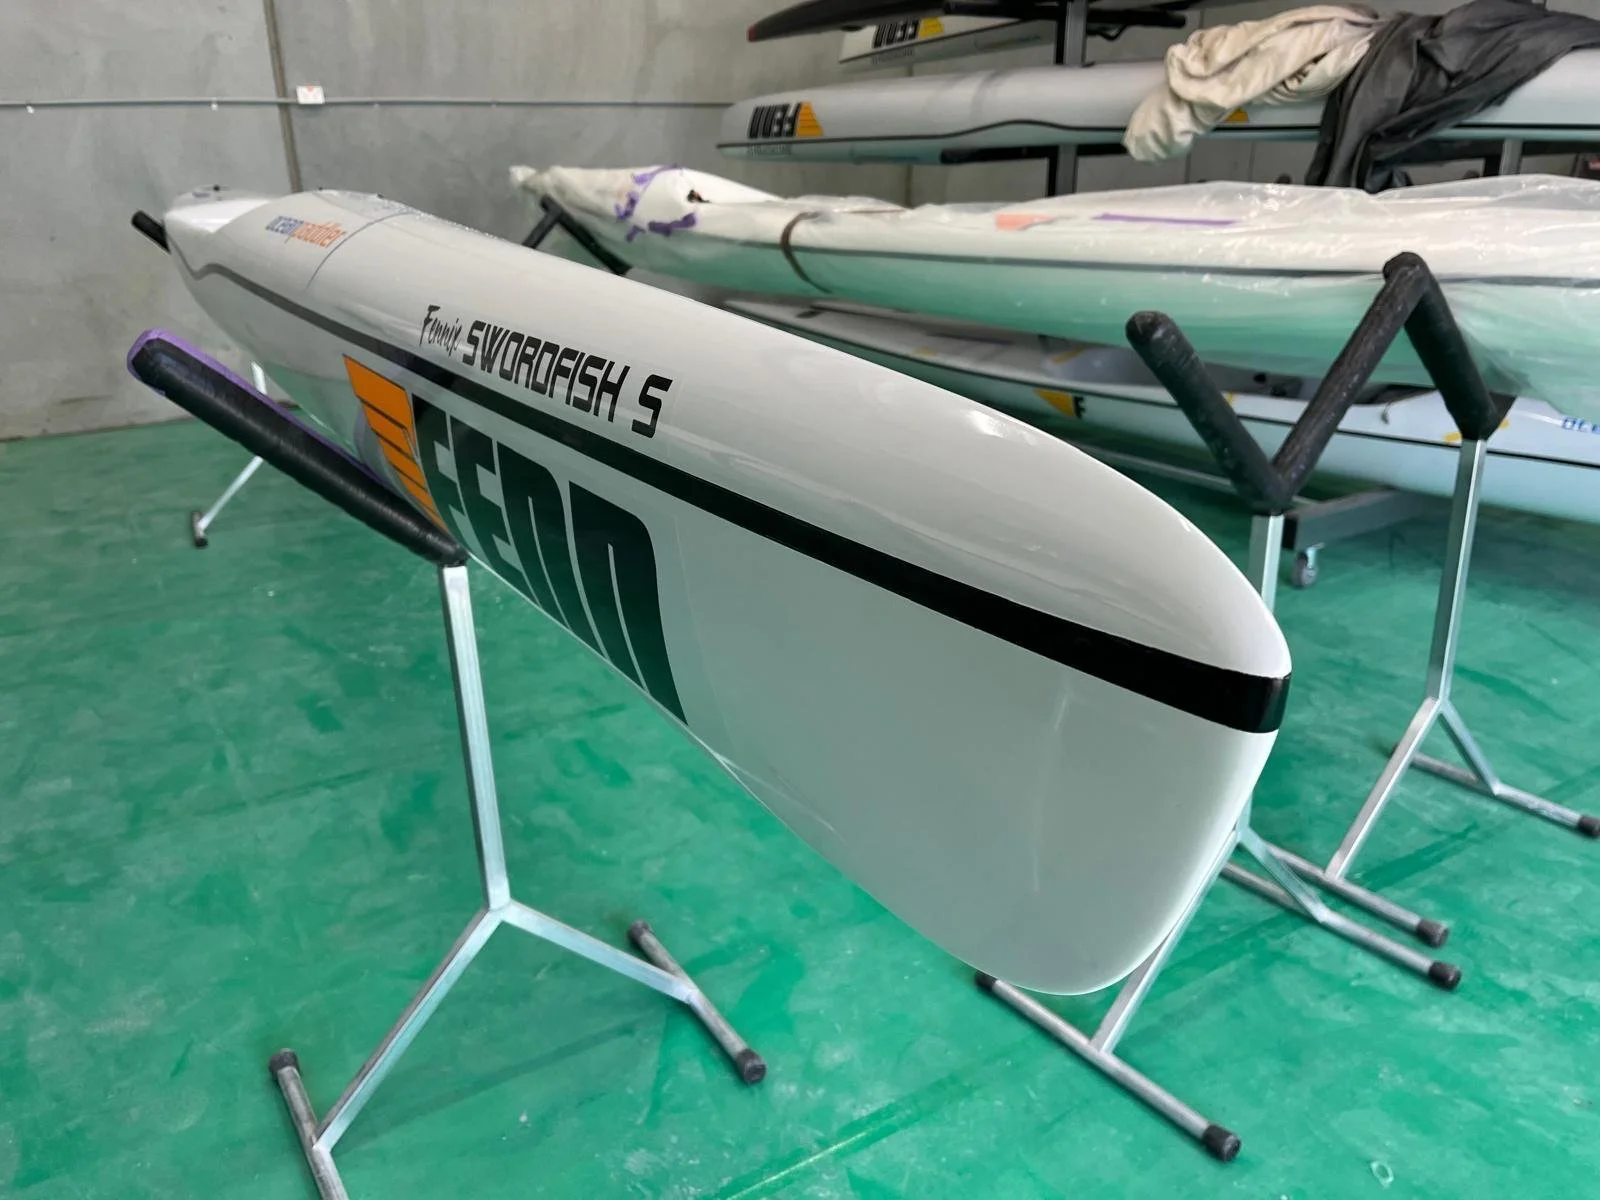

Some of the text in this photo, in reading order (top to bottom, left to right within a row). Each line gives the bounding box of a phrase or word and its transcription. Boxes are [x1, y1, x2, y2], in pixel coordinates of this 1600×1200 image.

[748, 102, 802, 139] FENN
[462, 320, 631, 423] SWORDFISH
[631, 374, 673, 439] S
[411, 392, 689, 726] FENN
